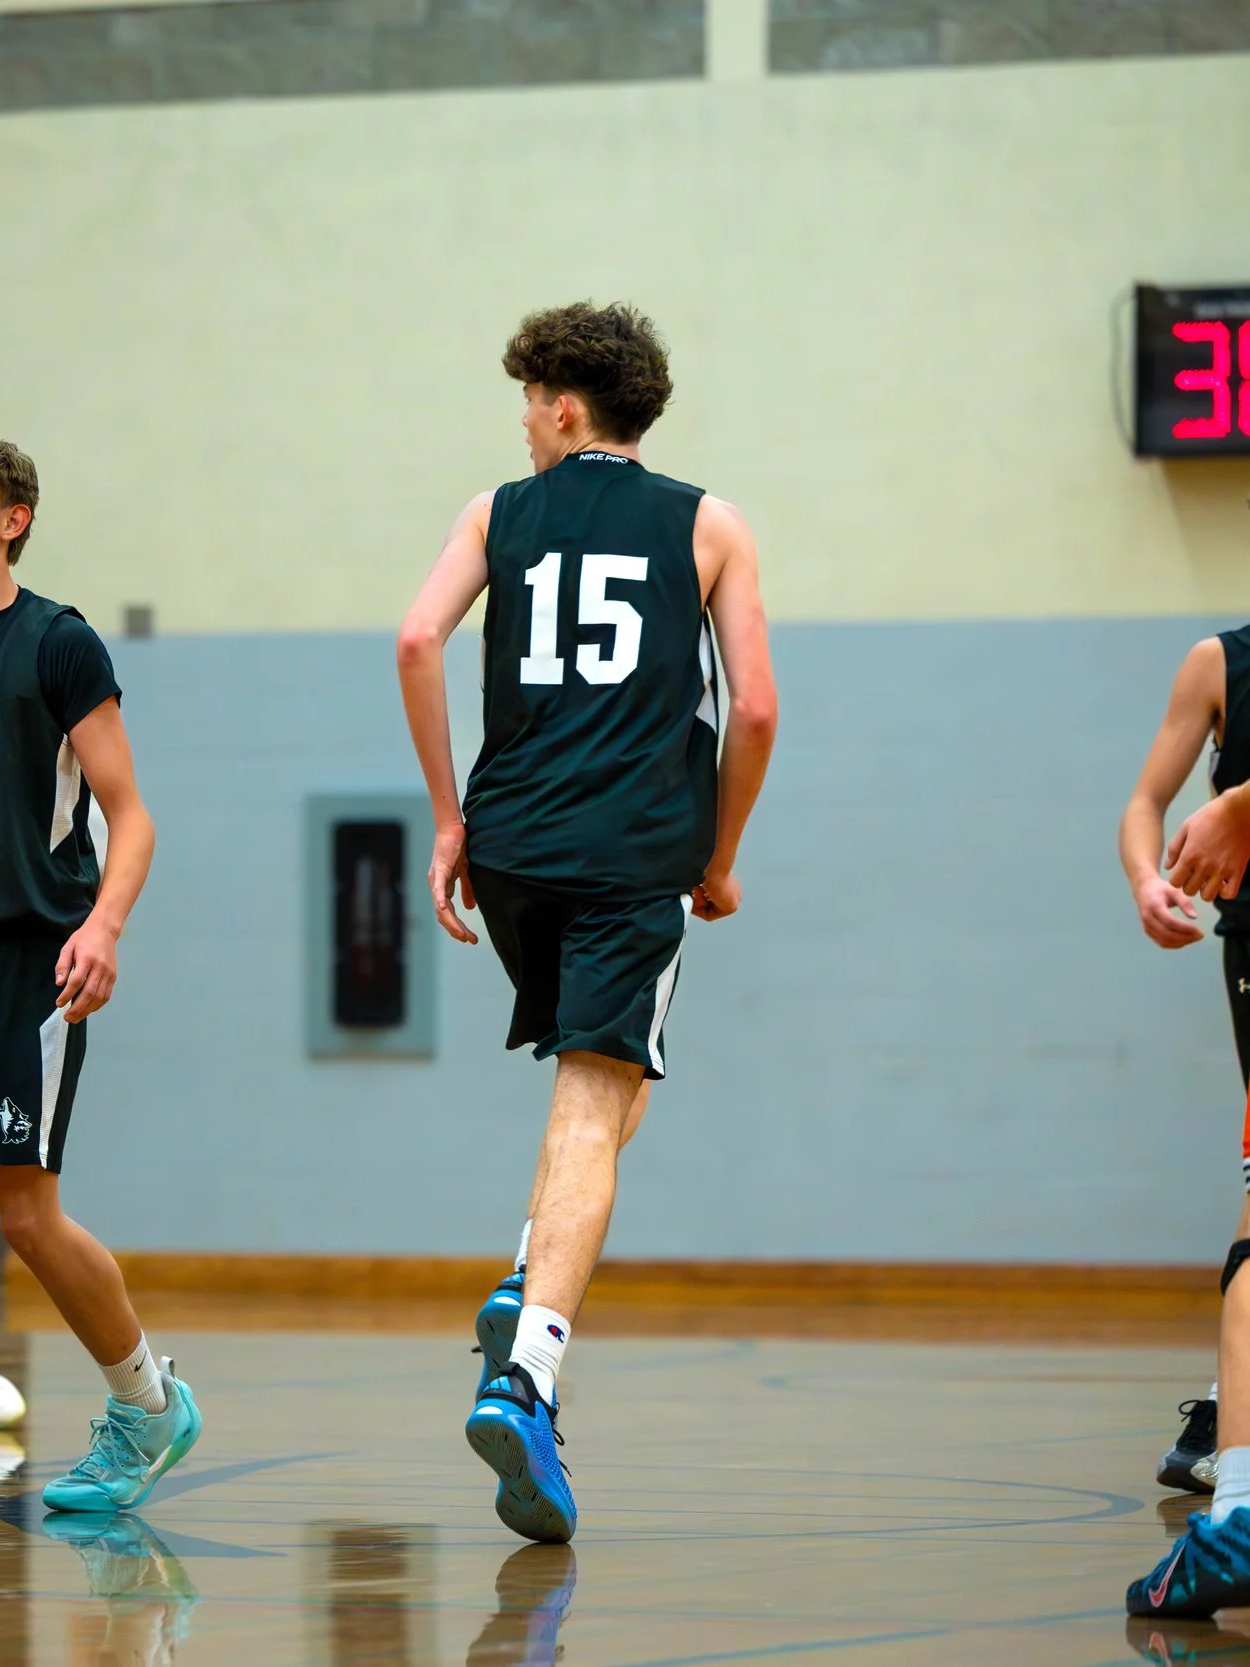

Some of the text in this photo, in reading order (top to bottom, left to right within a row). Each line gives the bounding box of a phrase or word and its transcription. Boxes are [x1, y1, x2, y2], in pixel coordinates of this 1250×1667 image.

[1171, 320, 1250, 439] 3
[579, 453, 628, 465] NIKE PRO
[519, 552, 649, 685] 15
